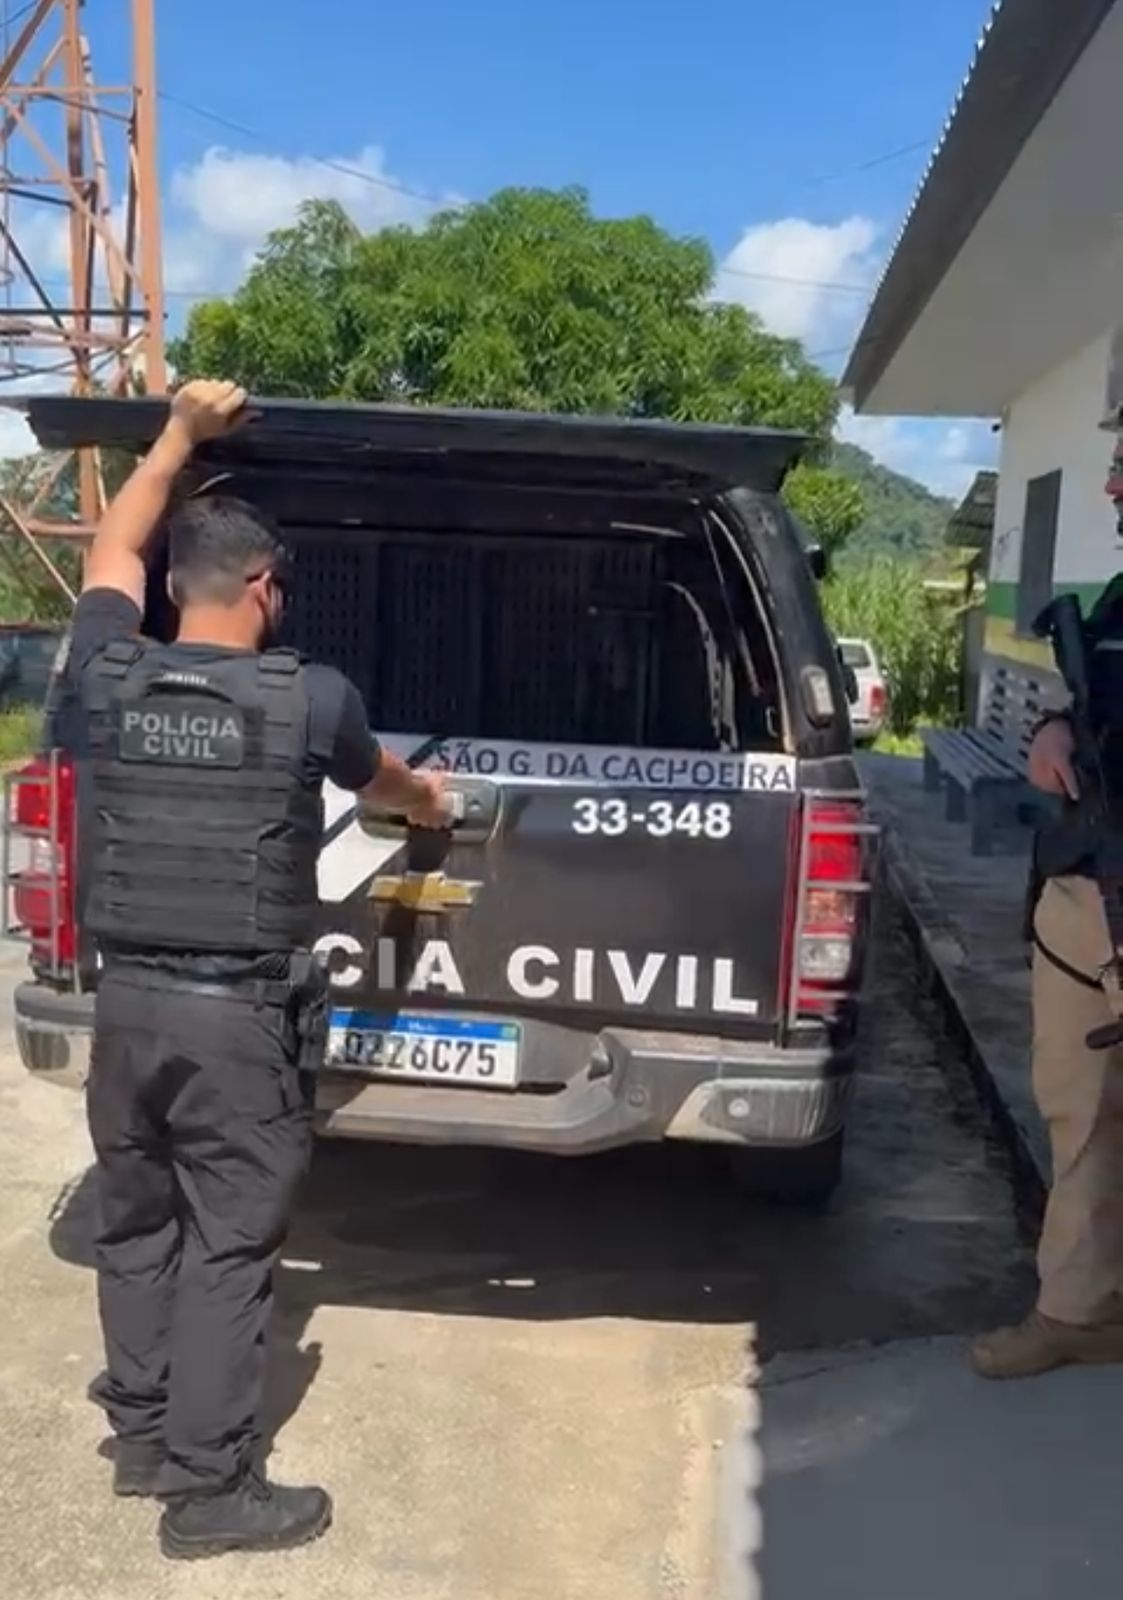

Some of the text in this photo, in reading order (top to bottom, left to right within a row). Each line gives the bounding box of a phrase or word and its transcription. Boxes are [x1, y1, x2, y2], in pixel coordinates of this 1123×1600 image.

[124, 710, 240, 739] POLÍCIA
[144, 735, 220, 759] CIVIL
[433, 740, 499, 774] SÃO
[546, 752, 591, 778] DA
[601, 755, 793, 790] CACHOEIRA
[571, 797, 732, 839] 33-348
[507, 944, 759, 1015] CIVIL
